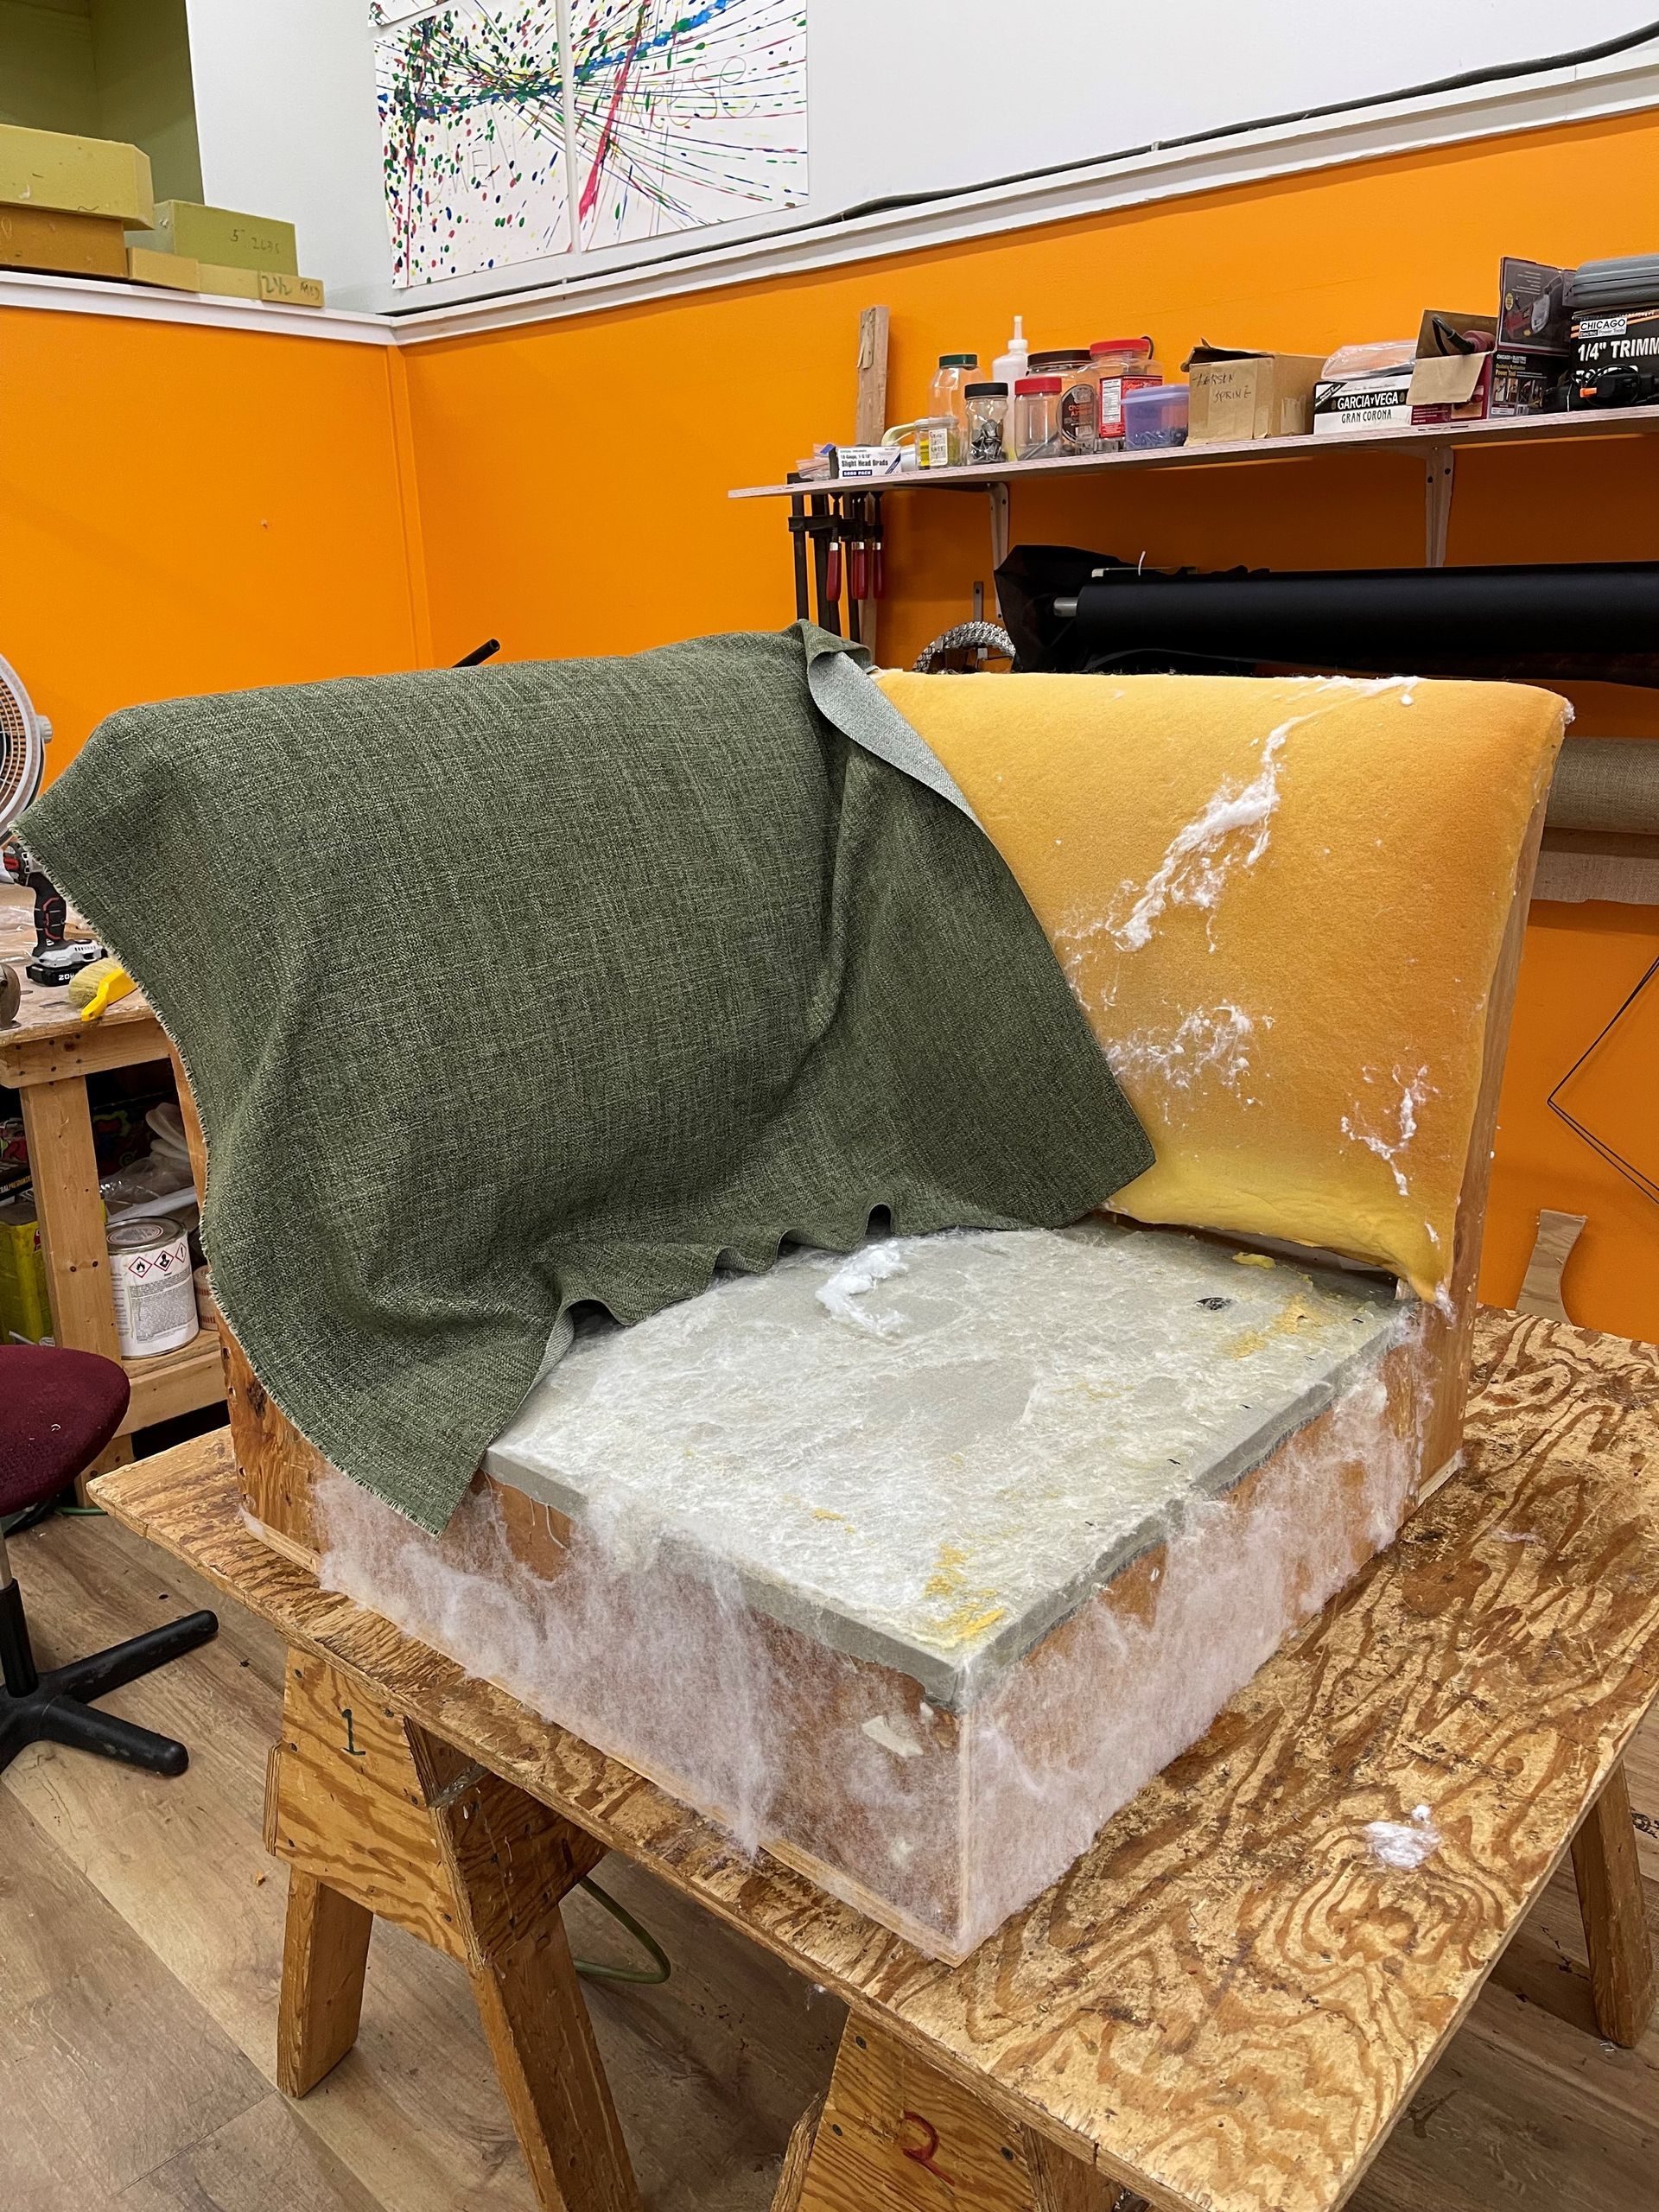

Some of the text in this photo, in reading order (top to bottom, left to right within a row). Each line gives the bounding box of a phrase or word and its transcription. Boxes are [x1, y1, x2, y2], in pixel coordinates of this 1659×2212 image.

[1580, 319, 1626, 330] CHICAGO
[1578, 341, 1607, 361] 1/4"
[1341, 409, 1392, 423] GRAN CORONA
